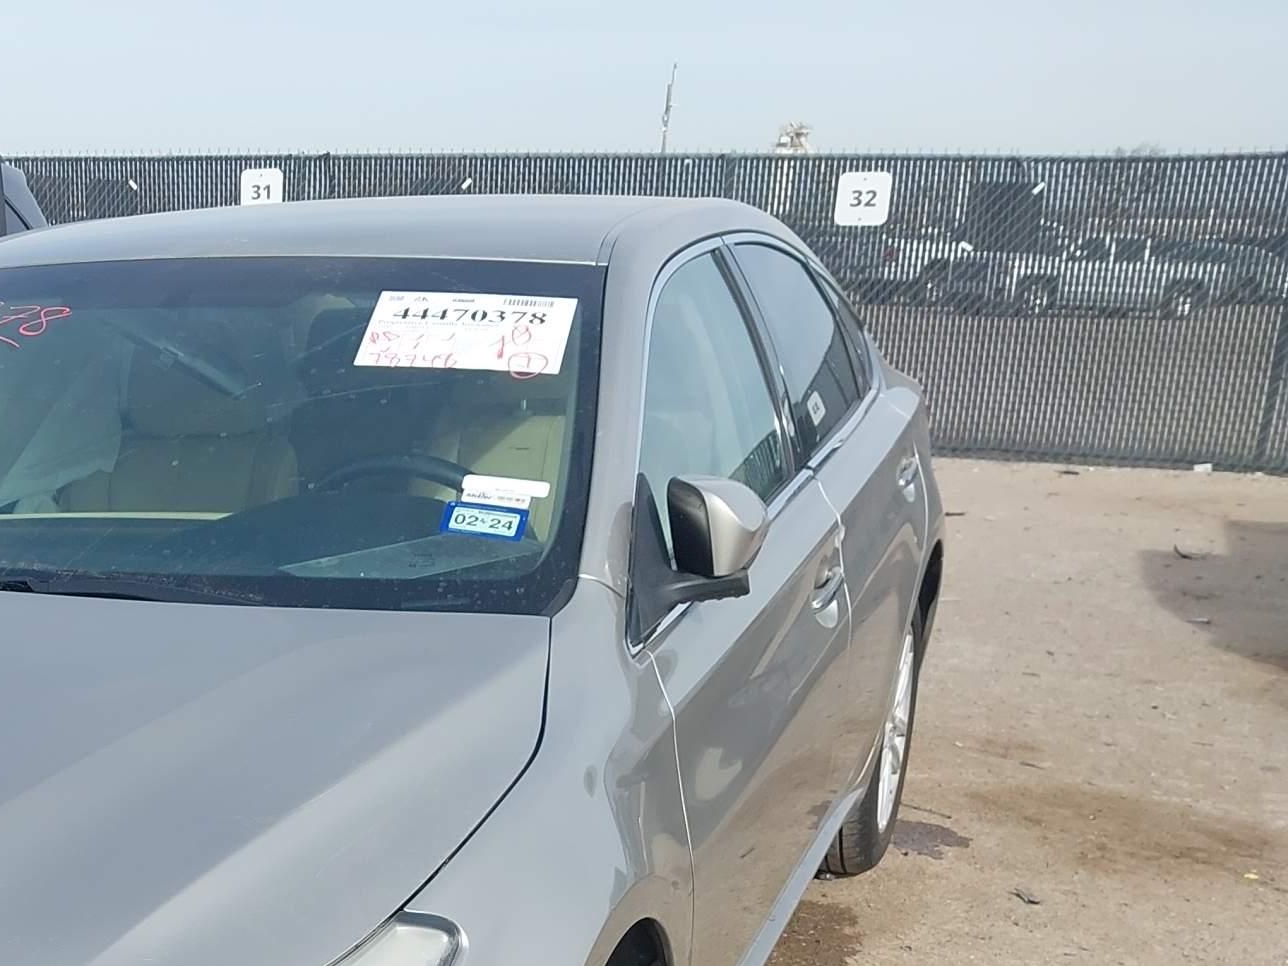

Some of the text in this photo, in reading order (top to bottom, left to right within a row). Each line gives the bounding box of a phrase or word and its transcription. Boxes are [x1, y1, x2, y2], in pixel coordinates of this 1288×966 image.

[251, 184, 271, 201] 31
[849, 190, 877, 207] 32
[392, 306, 548, 325] 44470378
